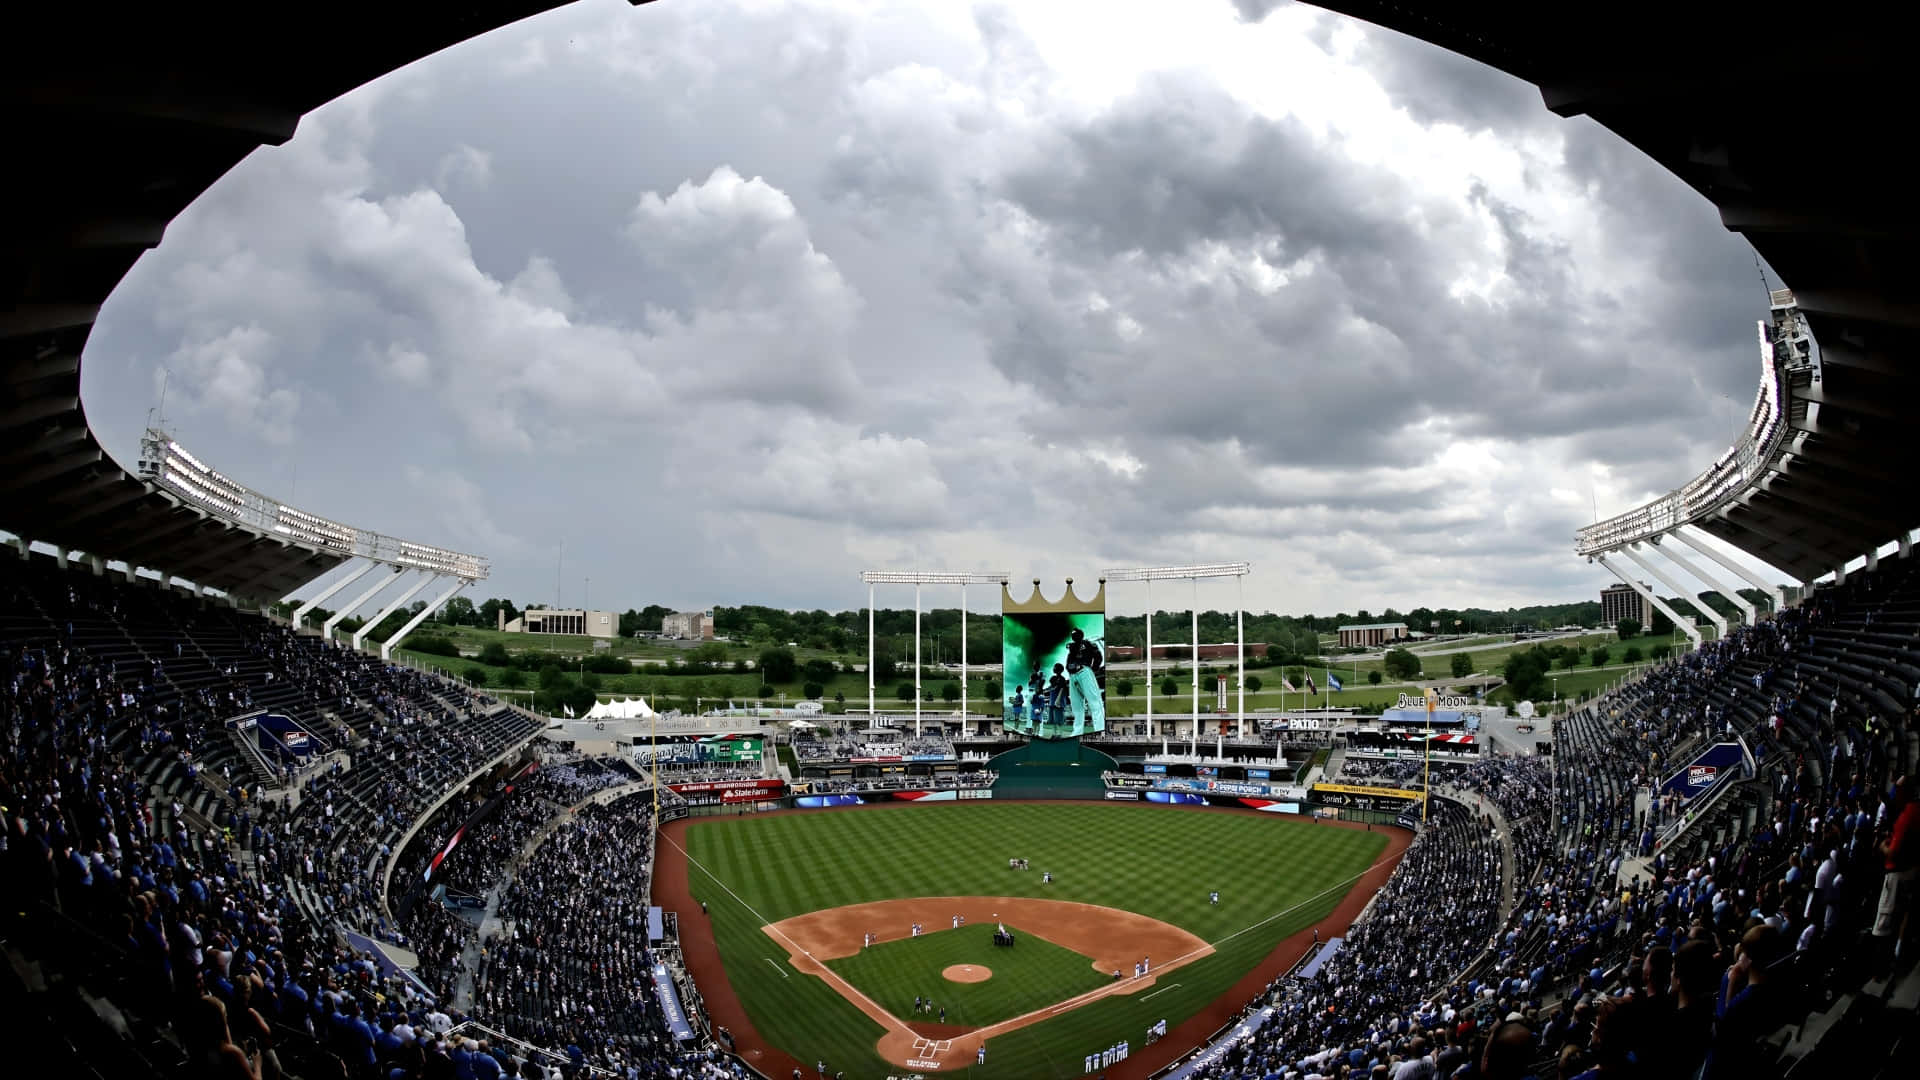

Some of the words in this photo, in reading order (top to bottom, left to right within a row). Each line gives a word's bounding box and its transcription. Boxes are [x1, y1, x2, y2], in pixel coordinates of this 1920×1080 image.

[1399, 692, 1424, 708] BLUE
[1438, 697, 1467, 706] MOON
[1290, 720, 1320, 728] PATIO
[1690, 768, 1704, 776] PRICE
[1322, 794, 1342, 804] Sprint
